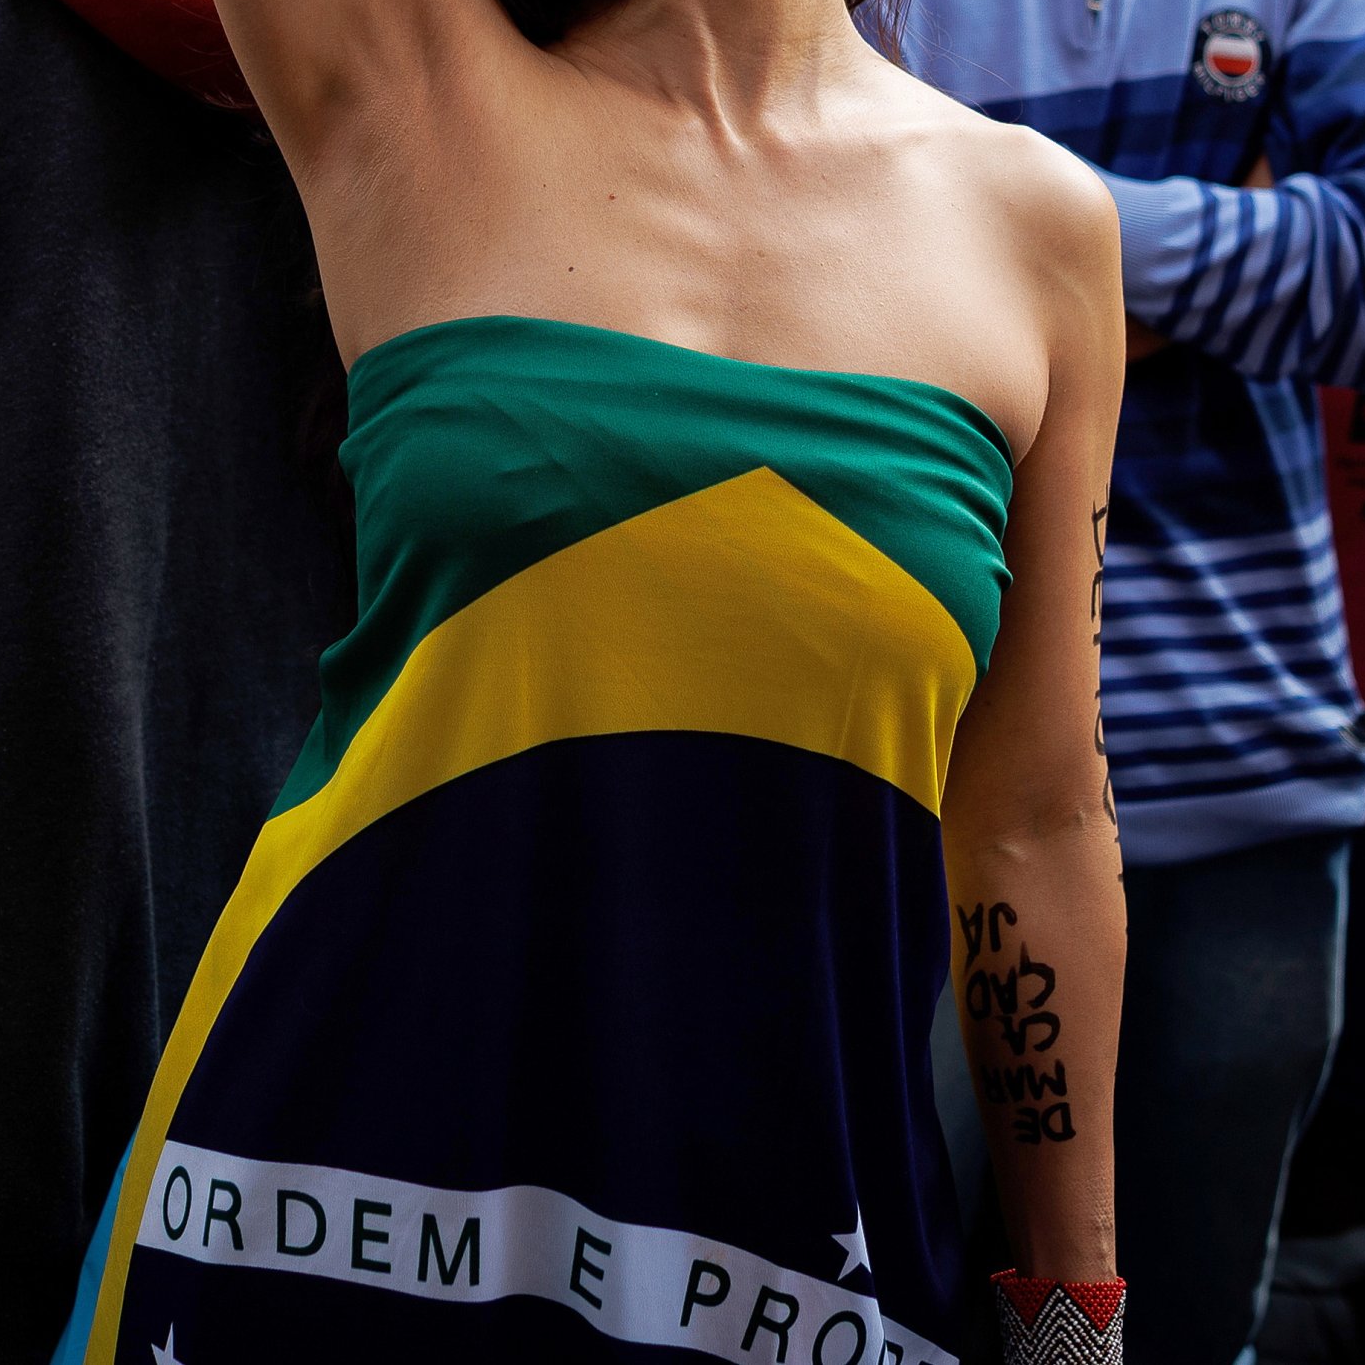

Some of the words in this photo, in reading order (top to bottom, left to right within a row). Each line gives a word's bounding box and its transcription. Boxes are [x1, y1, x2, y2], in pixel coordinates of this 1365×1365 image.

[1011, 1101, 1077, 1145] DE
[162, 1165, 482, 1287] ORDEM
[569, 1227, 613, 1311] E
